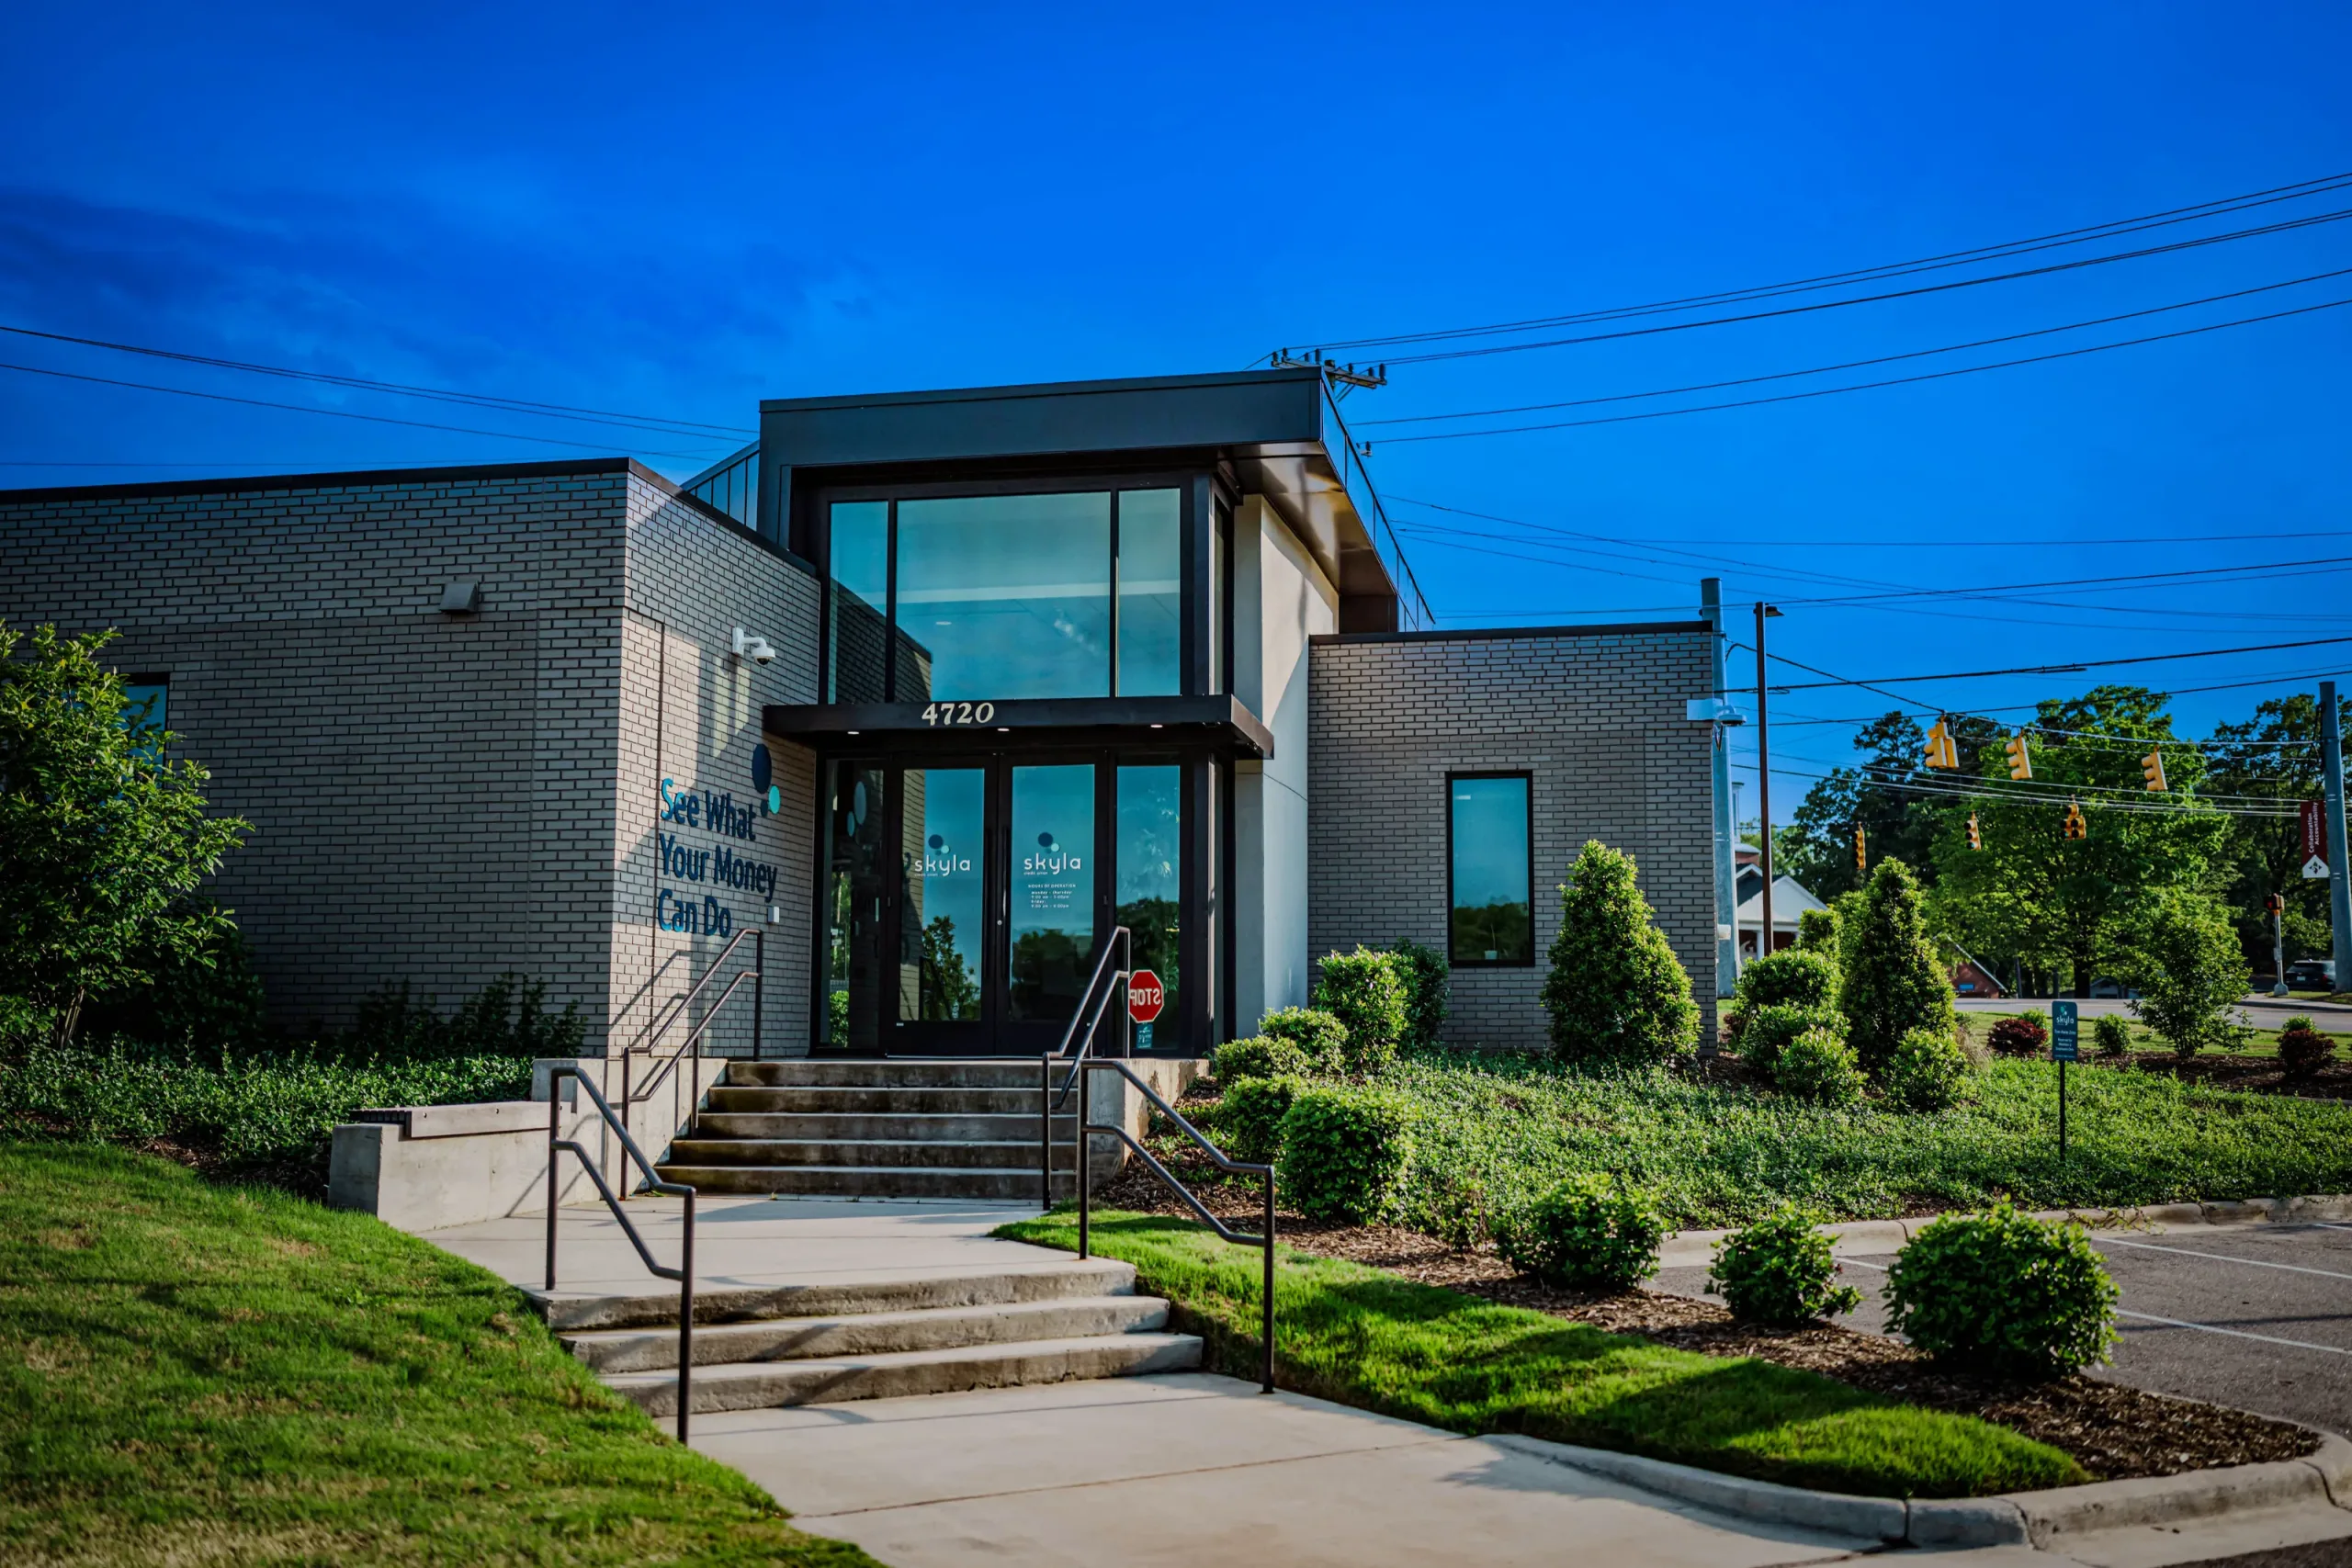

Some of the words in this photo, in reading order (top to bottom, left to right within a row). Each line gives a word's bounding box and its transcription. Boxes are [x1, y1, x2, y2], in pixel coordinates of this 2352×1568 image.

[922, 702, 994, 726] 4720
[661, 778, 700, 827] See
[705, 789, 756, 840] What
[660, 833, 710, 882] Your
[713, 845, 778, 903] Money
[914, 854, 970, 876] skyla
[1023, 852, 1081, 874] skyla
[658, 888, 698, 934] Can
[704, 895, 732, 939] Do
[2056, 1015, 2075, 1026] skyla
